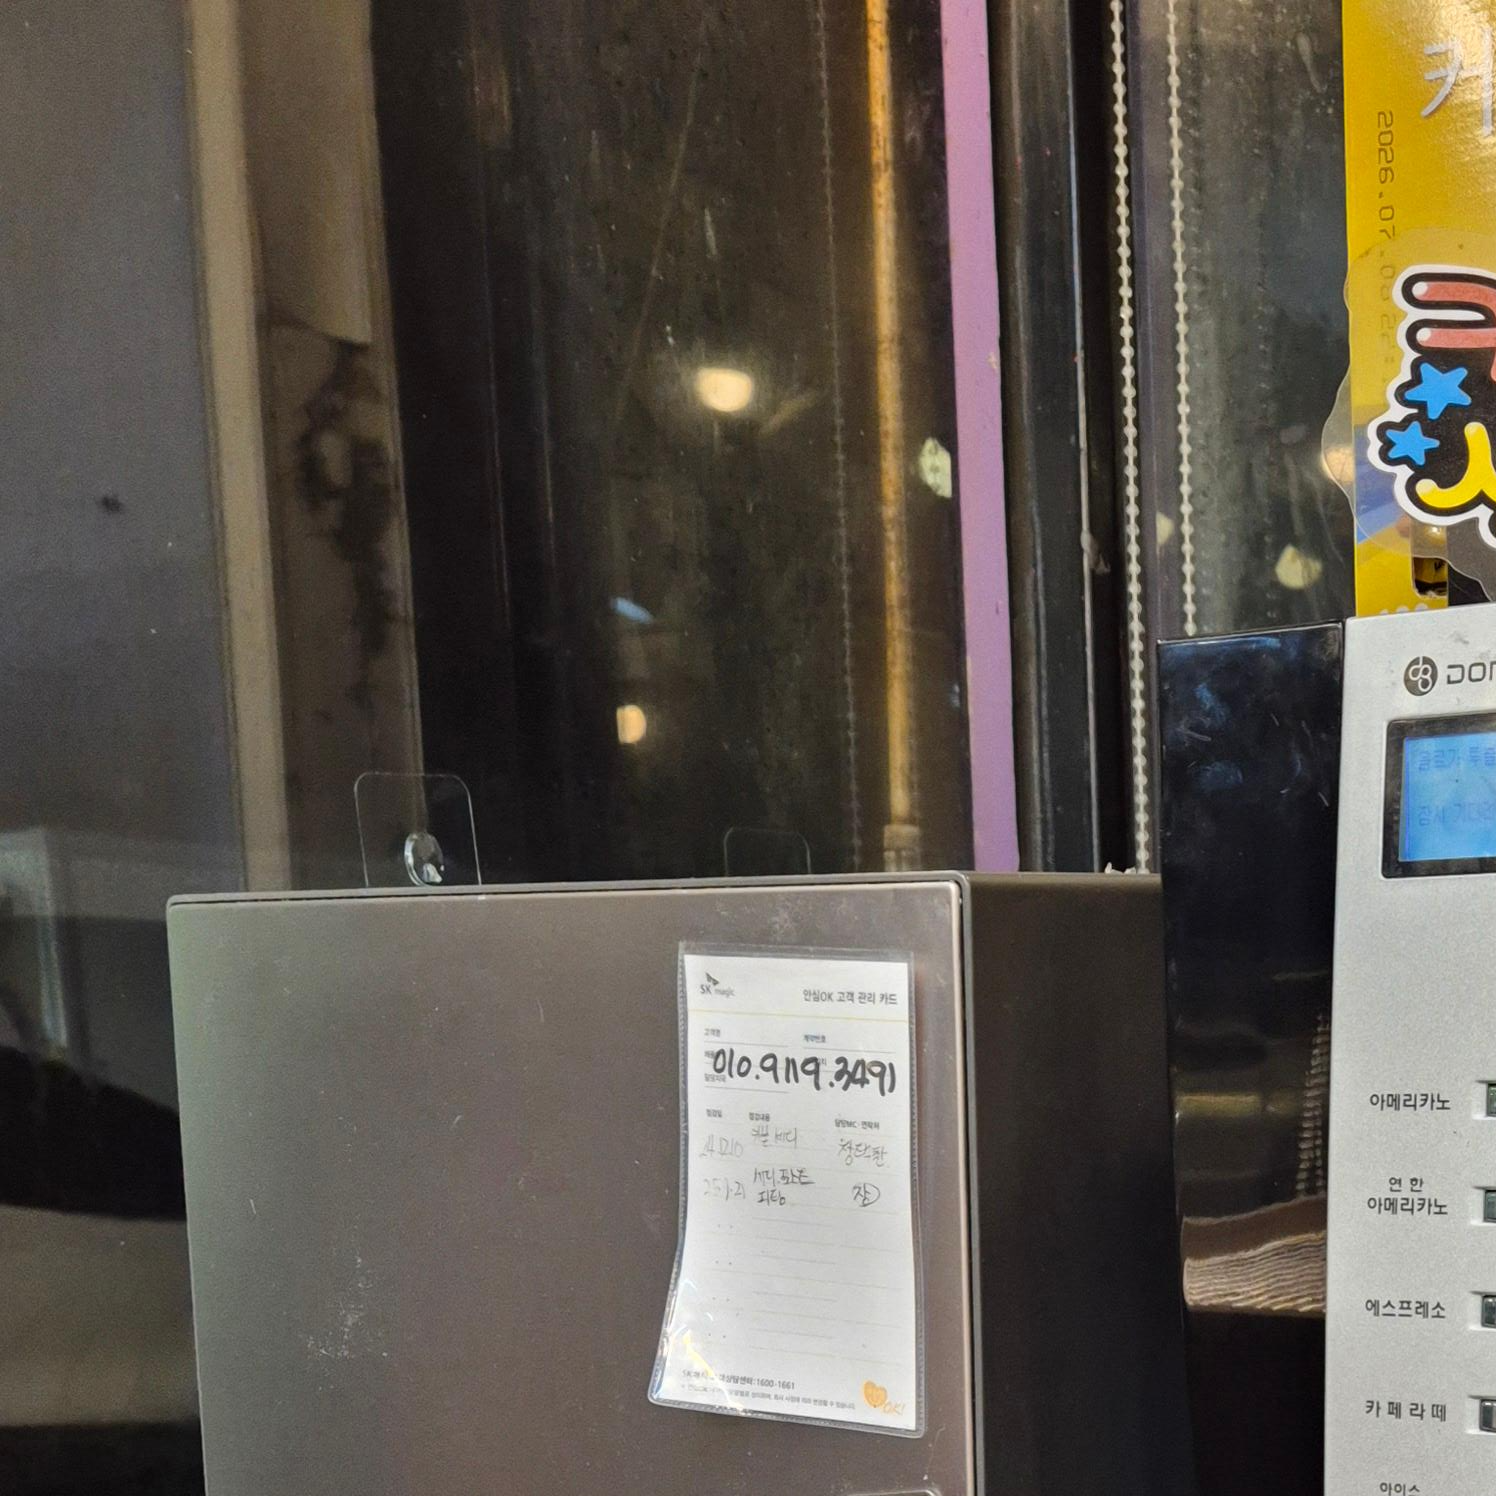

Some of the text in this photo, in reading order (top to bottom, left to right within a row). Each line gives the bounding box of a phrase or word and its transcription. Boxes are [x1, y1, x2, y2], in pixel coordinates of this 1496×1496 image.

[836, 990, 856, 1004] 고객
[857, 991, 877, 1005] 관리
[879, 992, 899, 1006] 카드
[1369, 1092, 1452, 1112] 아메리카노
[1388, 1176, 1425, 1194] 연한
[1366, 1196, 1449, 1216] 아메리카노
[1364, 1298, 1447, 1320] 에스프레소
[1364, 1400, 1448, 1423] 카페라떼
